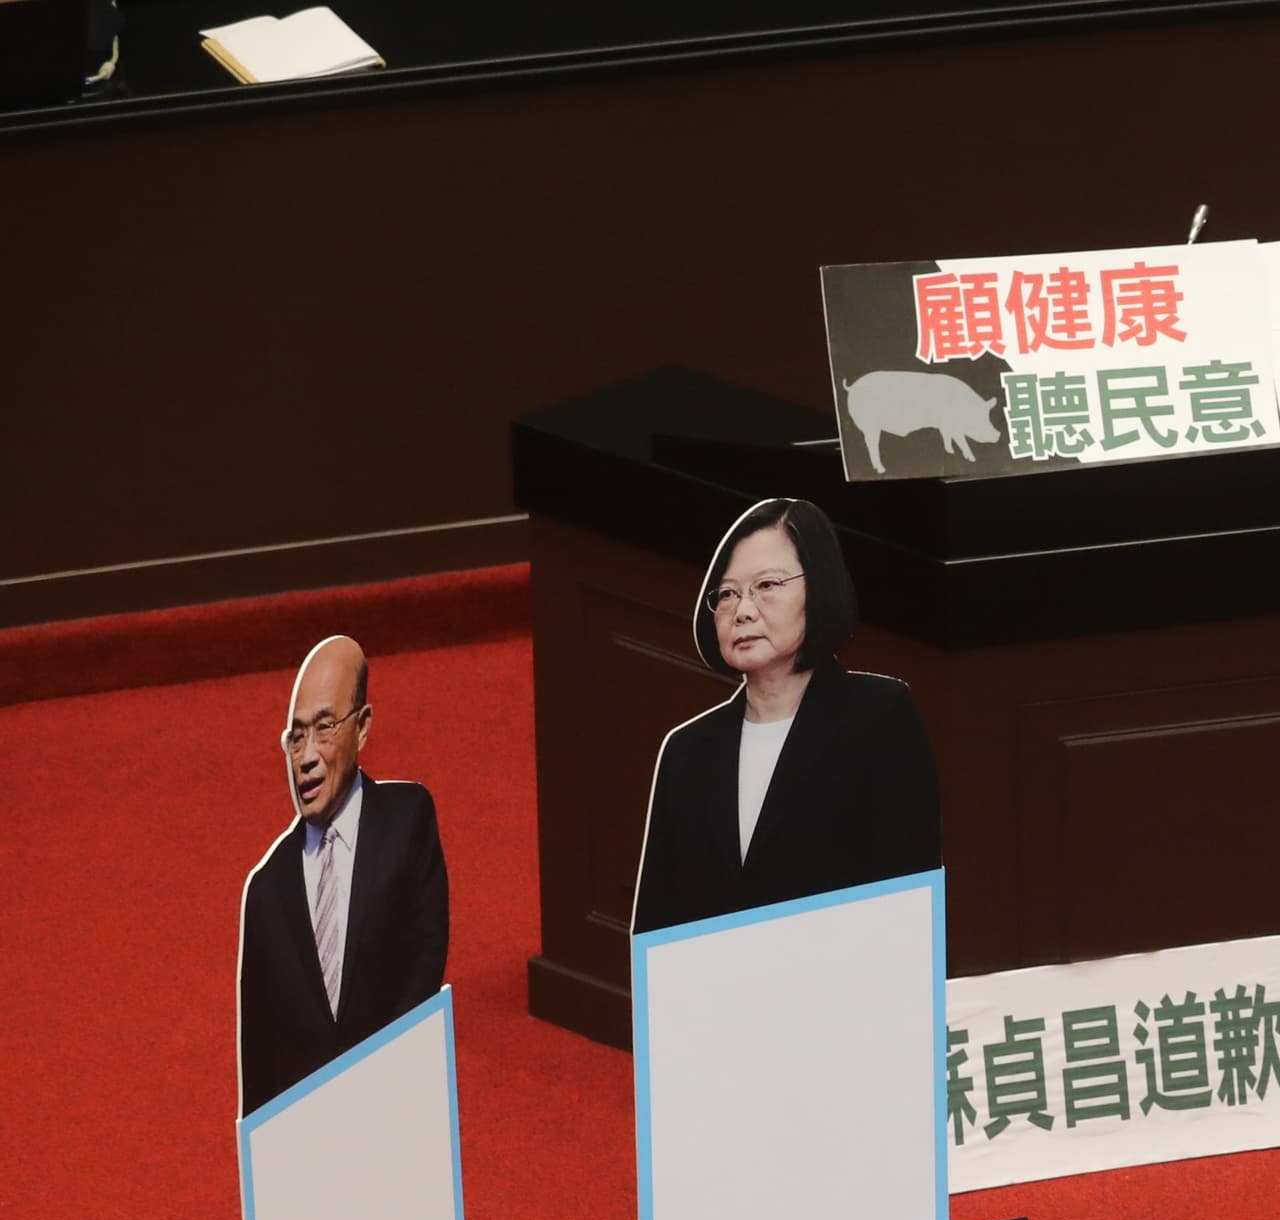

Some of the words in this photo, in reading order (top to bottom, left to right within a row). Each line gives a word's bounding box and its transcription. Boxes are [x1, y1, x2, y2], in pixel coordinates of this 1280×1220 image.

[914, 262, 1188, 360] 顧健康
[1004, 360, 1265, 459] 聽民意
